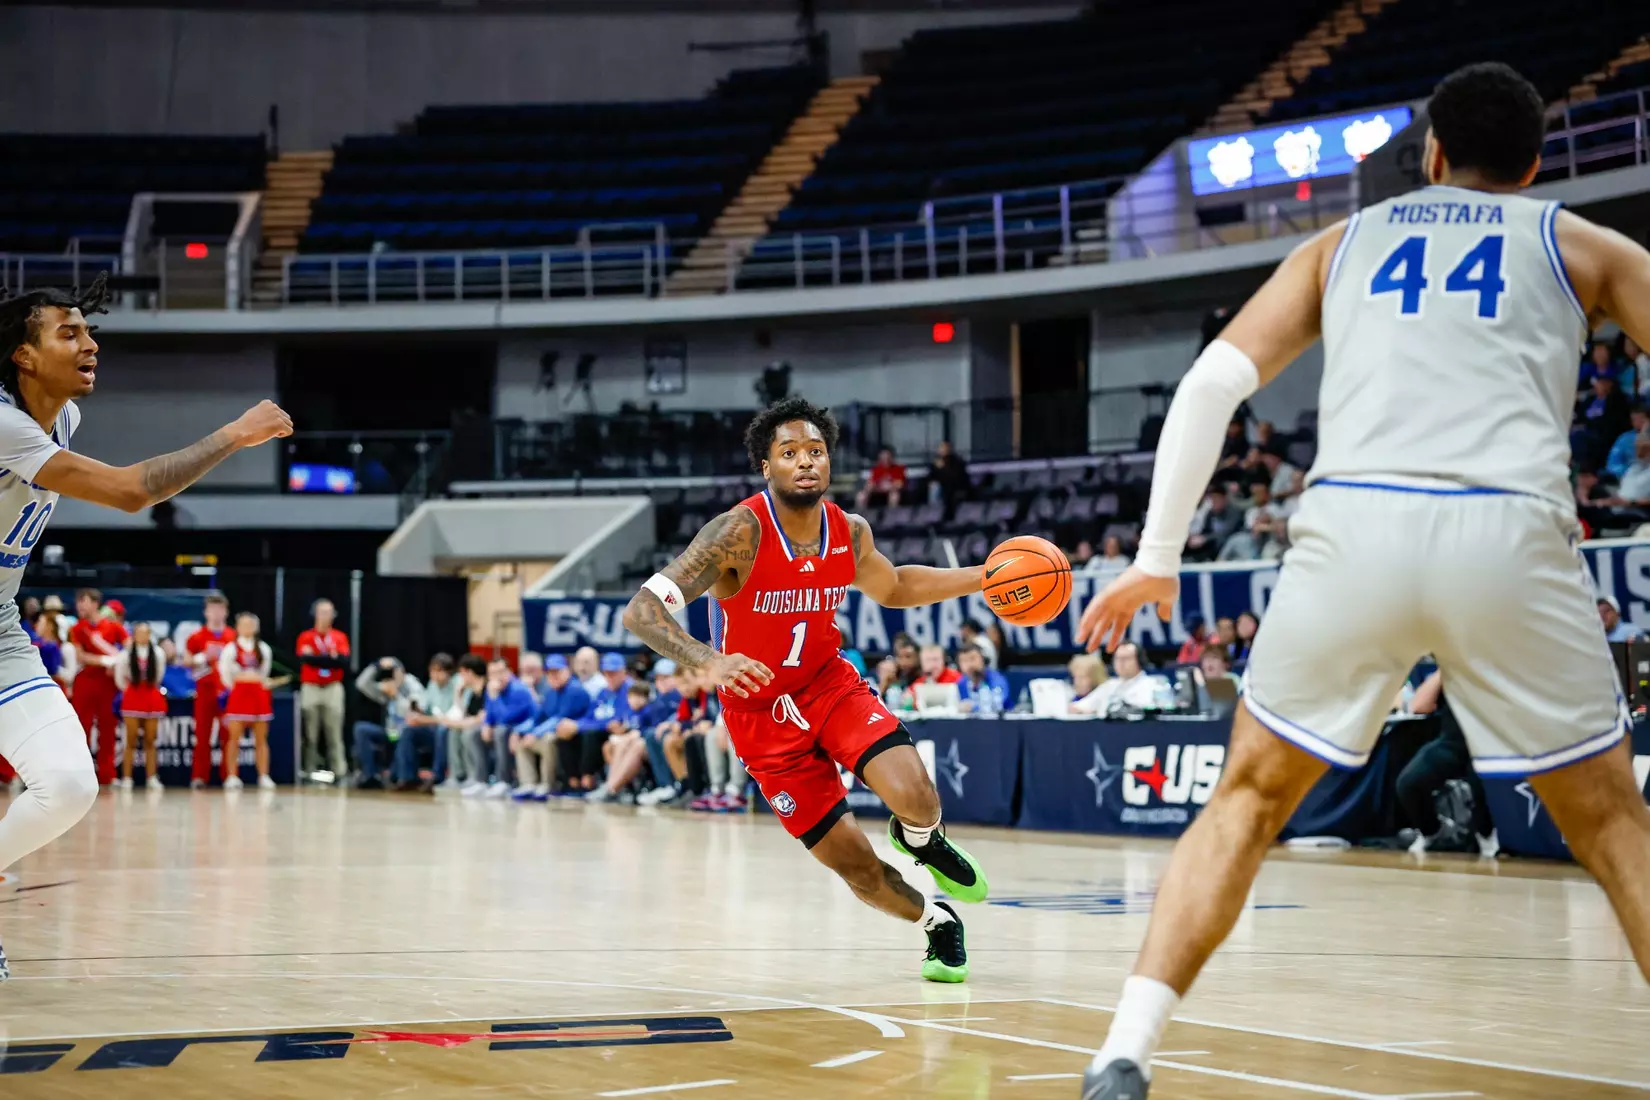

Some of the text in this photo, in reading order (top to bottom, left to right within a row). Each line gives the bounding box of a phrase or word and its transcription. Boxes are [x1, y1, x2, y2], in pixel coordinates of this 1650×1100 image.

[1387, 203, 1504, 224] MOSTAFA
[1368, 234, 1507, 320] 44
[3, 501, 53, 549] 10
[752, 588, 820, 614] LOUISIANA
[989, 584, 1032, 606] ELITE
[782, 621, 808, 667] 1
